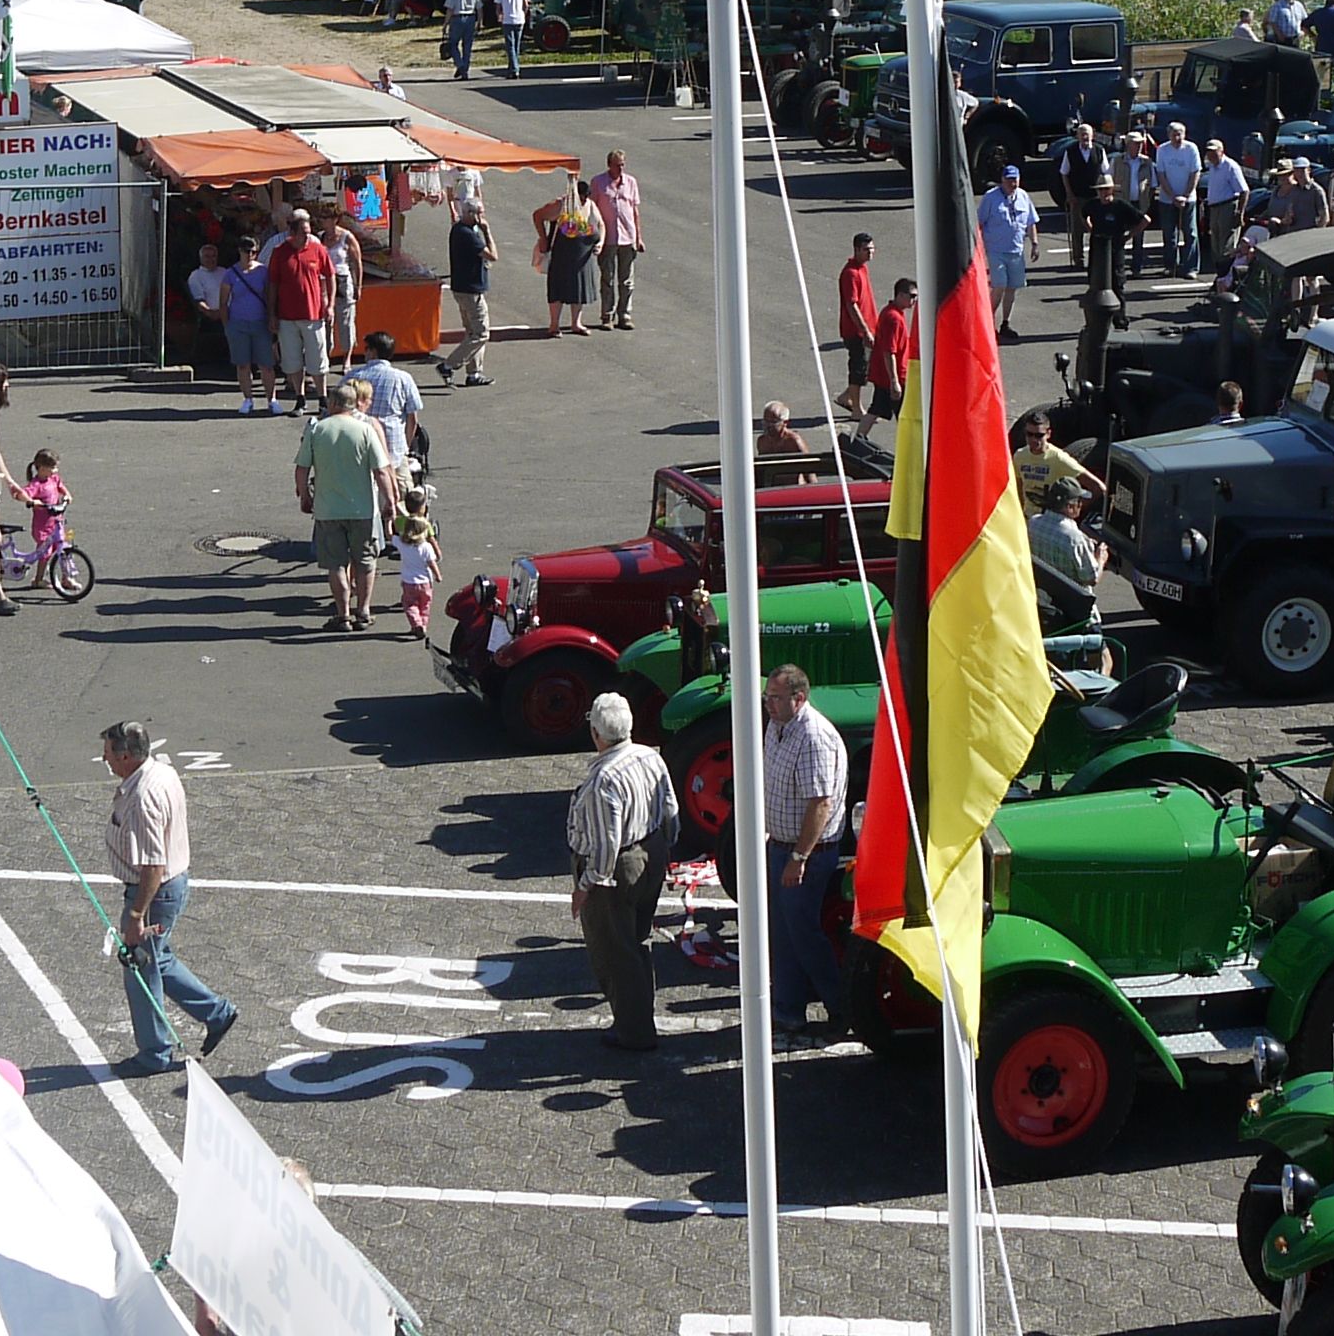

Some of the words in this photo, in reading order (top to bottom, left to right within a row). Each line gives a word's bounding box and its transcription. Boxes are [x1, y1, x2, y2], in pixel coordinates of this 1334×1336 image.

[43, 133, 112, 152] NACH:
[44, 162, 112, 178] Machern
[11, 187, 85, 203] Zeltingen
[32, 267, 67, 283] 11.35
[81, 263, 116, 279] 12.05
[32, 290, 68, 306] 14.50
[81, 286, 117, 303] 16.50
[1146, 577, 1160, 593] EZ
[814, 621, 830, 633] Z2
[265, 951, 515, 1101] BUS
